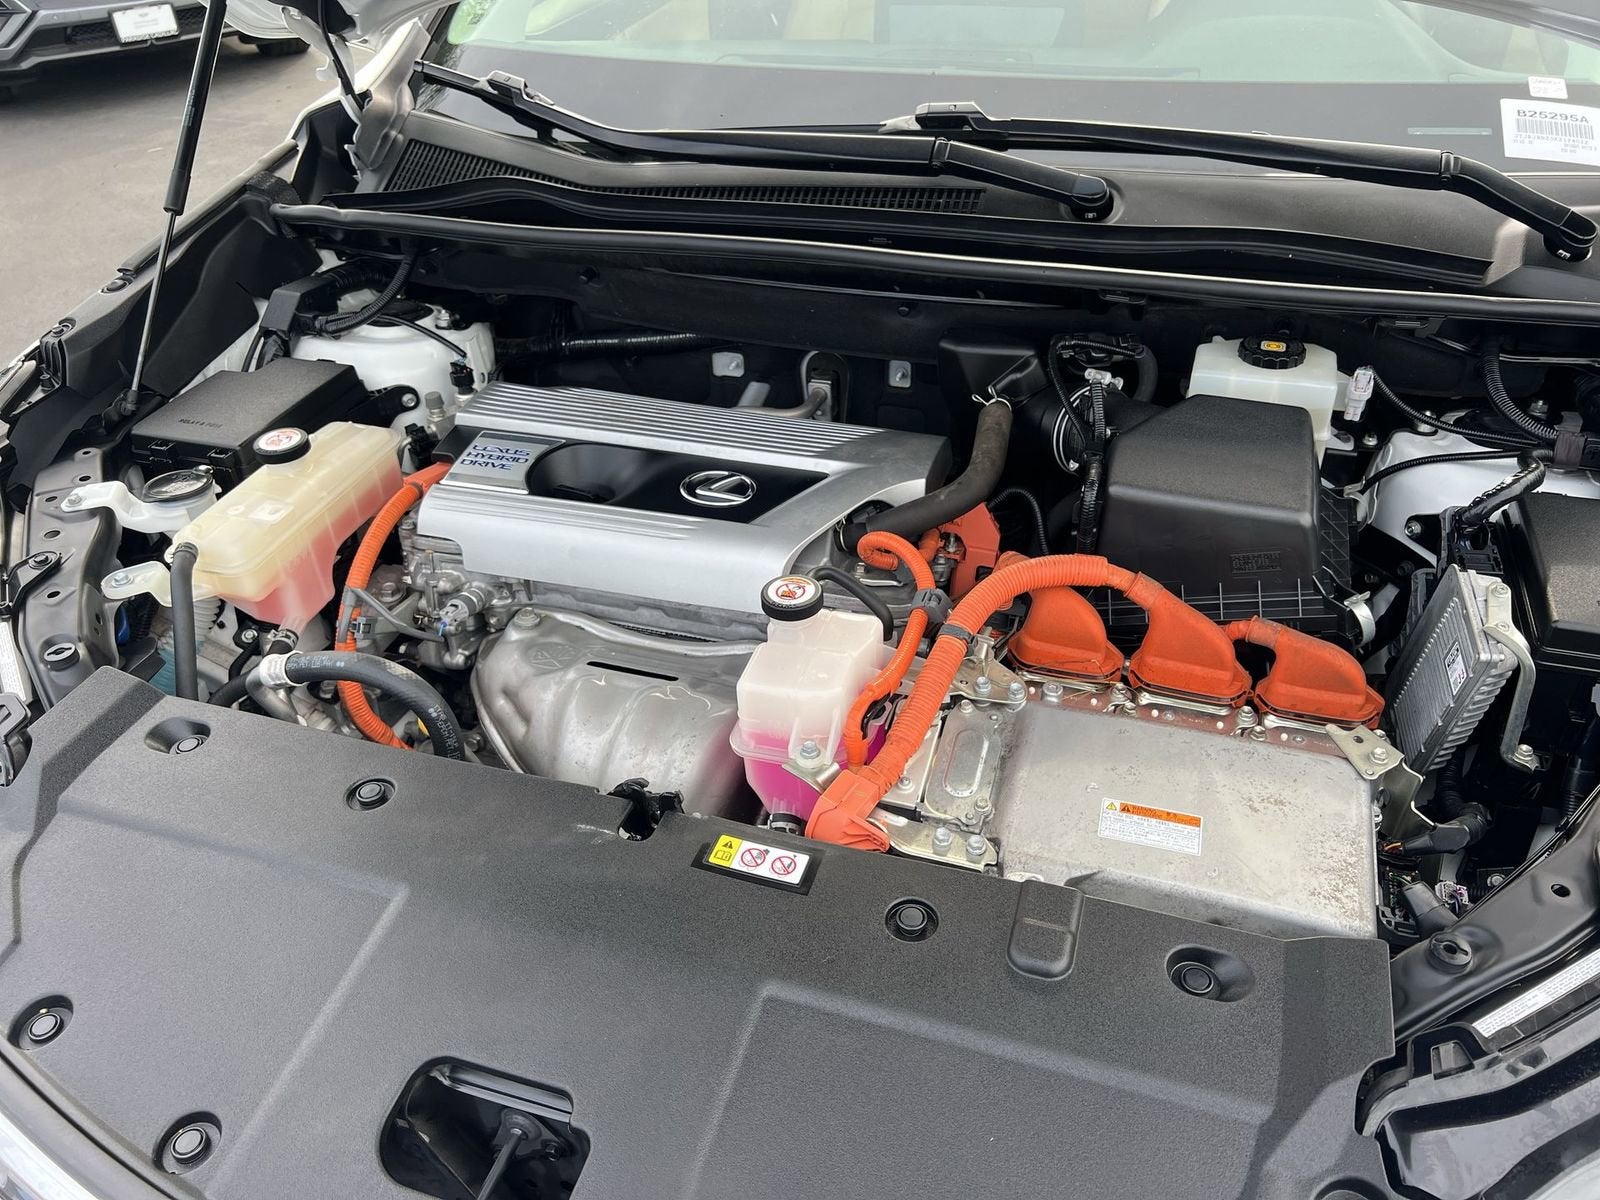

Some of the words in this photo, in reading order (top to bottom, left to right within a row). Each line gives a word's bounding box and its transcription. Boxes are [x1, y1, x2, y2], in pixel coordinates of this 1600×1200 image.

[1516, 109, 1590, 124] B25295A
[472, 444, 530, 456] LEXUS
[465, 451, 529, 464] HYBRID
[460, 458, 513, 471] DRIVE
